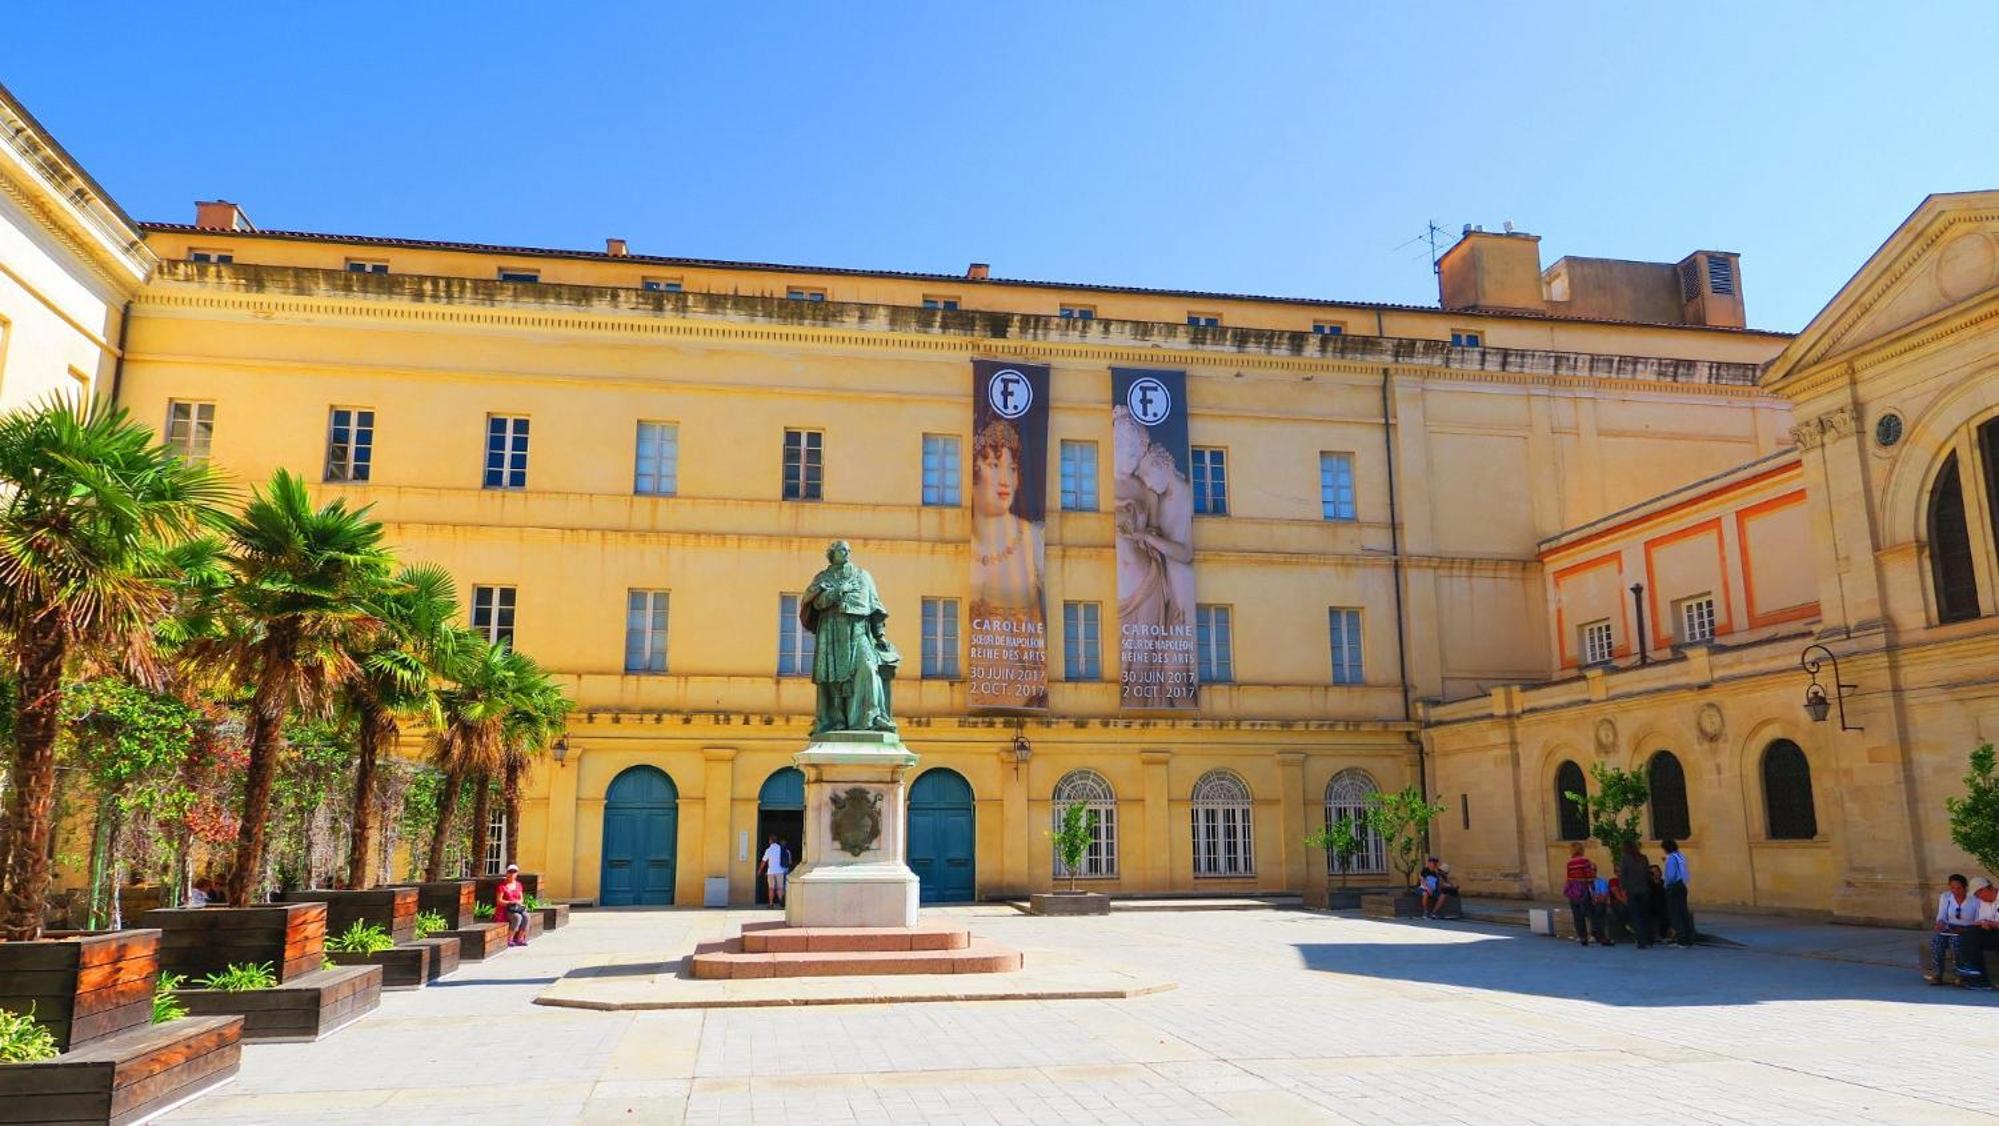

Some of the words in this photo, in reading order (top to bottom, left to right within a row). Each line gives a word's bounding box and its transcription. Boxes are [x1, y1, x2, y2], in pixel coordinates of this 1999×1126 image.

[1000, 378, 1020, 410] F.
[1138, 385, 1158, 418] F.
[972, 619, 1044, 634] CAROLINE
[1122, 623, 1193, 636] CAROLINE
[970, 646, 999, 659] REINE
[1002, 649, 1019, 660] DES
[1022, 650, 1046, 662] ARTS
[1121, 651, 1149, 663] REINE
[1152, 652, 1168, 663] DES
[1172, 652, 1194, 664] ARTS
[970, 666, 985, 679] 30
[986, 667, 1014, 680] JUIN
[1017, 669, 1046, 682] 2017
[1122, 671, 1136, 683] 30
[1138, 671, 1165, 683] JUIN
[1167, 672, 1195, 683] 2017
[969, 681, 978, 694] 2
[1015, 684, 1045, 697] 2017
[1123, 685, 1130, 697] 2
[1166, 686, 1195, 698] 2017
